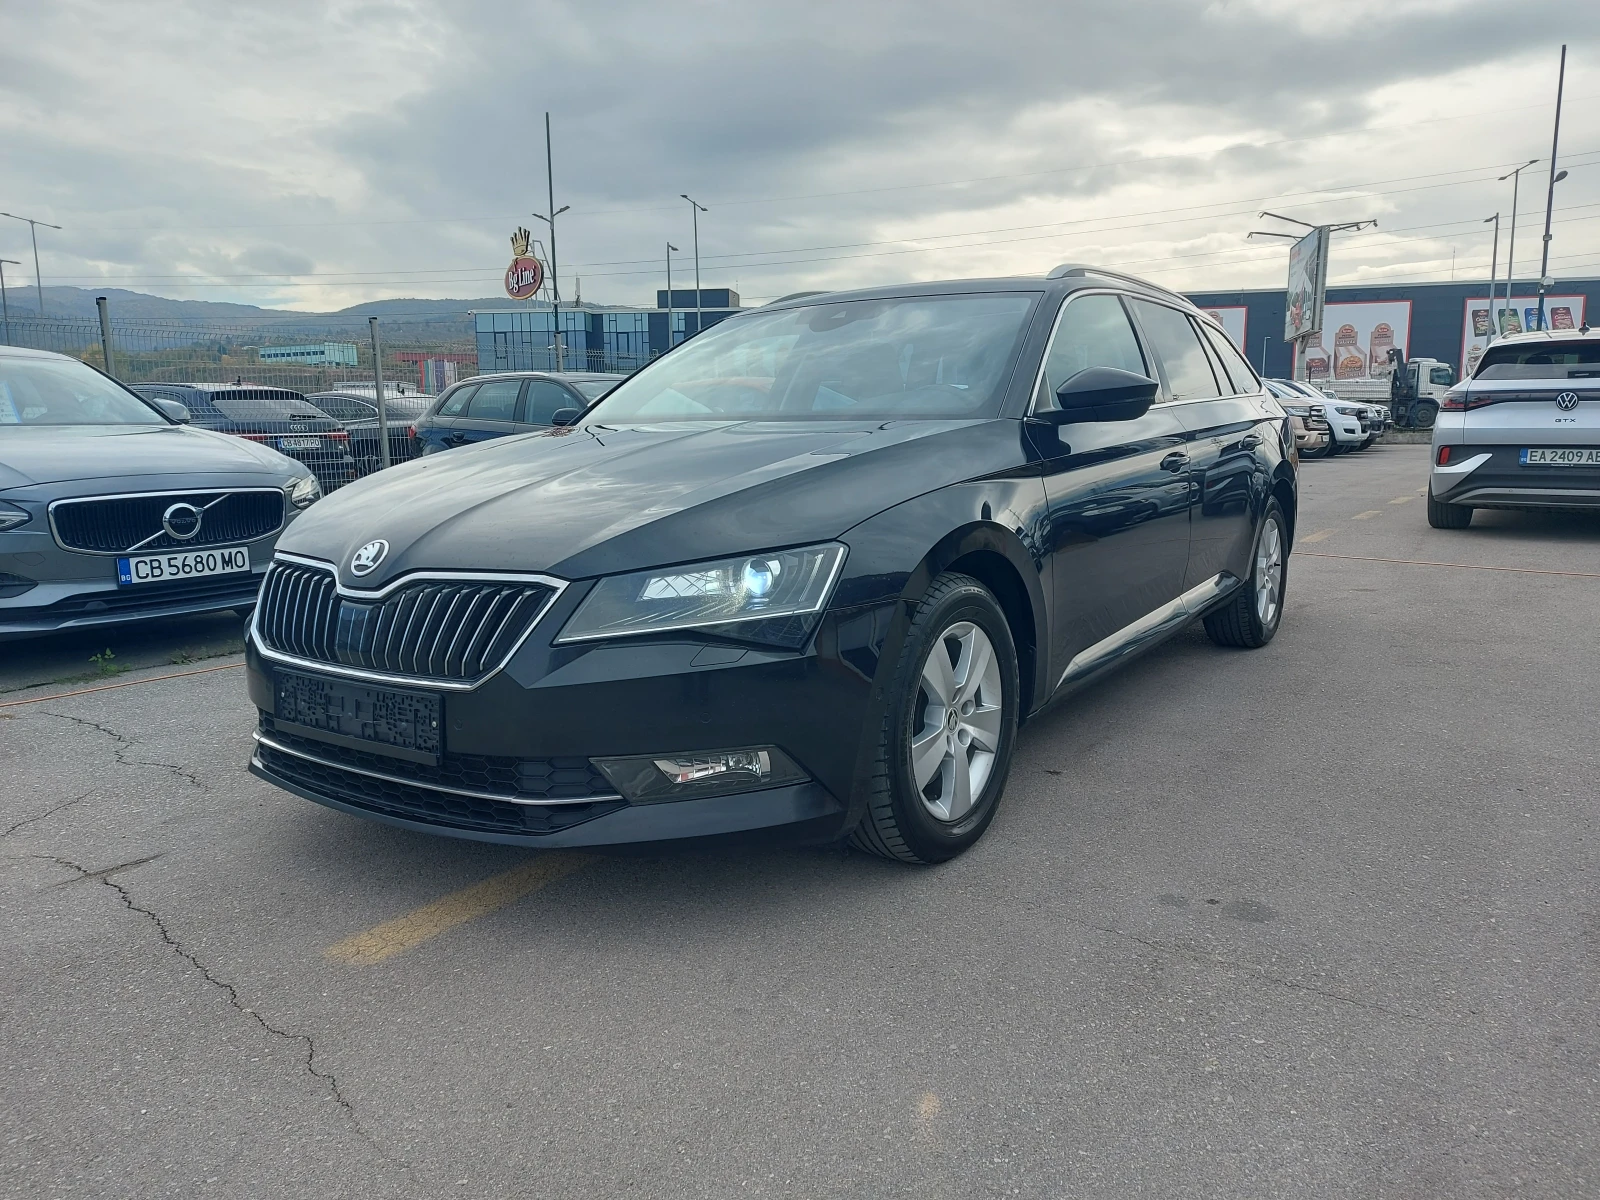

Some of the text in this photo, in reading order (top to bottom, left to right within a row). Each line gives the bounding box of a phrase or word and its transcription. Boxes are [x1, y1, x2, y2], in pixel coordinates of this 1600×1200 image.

[1529, 450, 1546, 462] EA
[1550, 450, 1583, 463] 2409
[134, 550, 246, 580] CB 5680 MO
